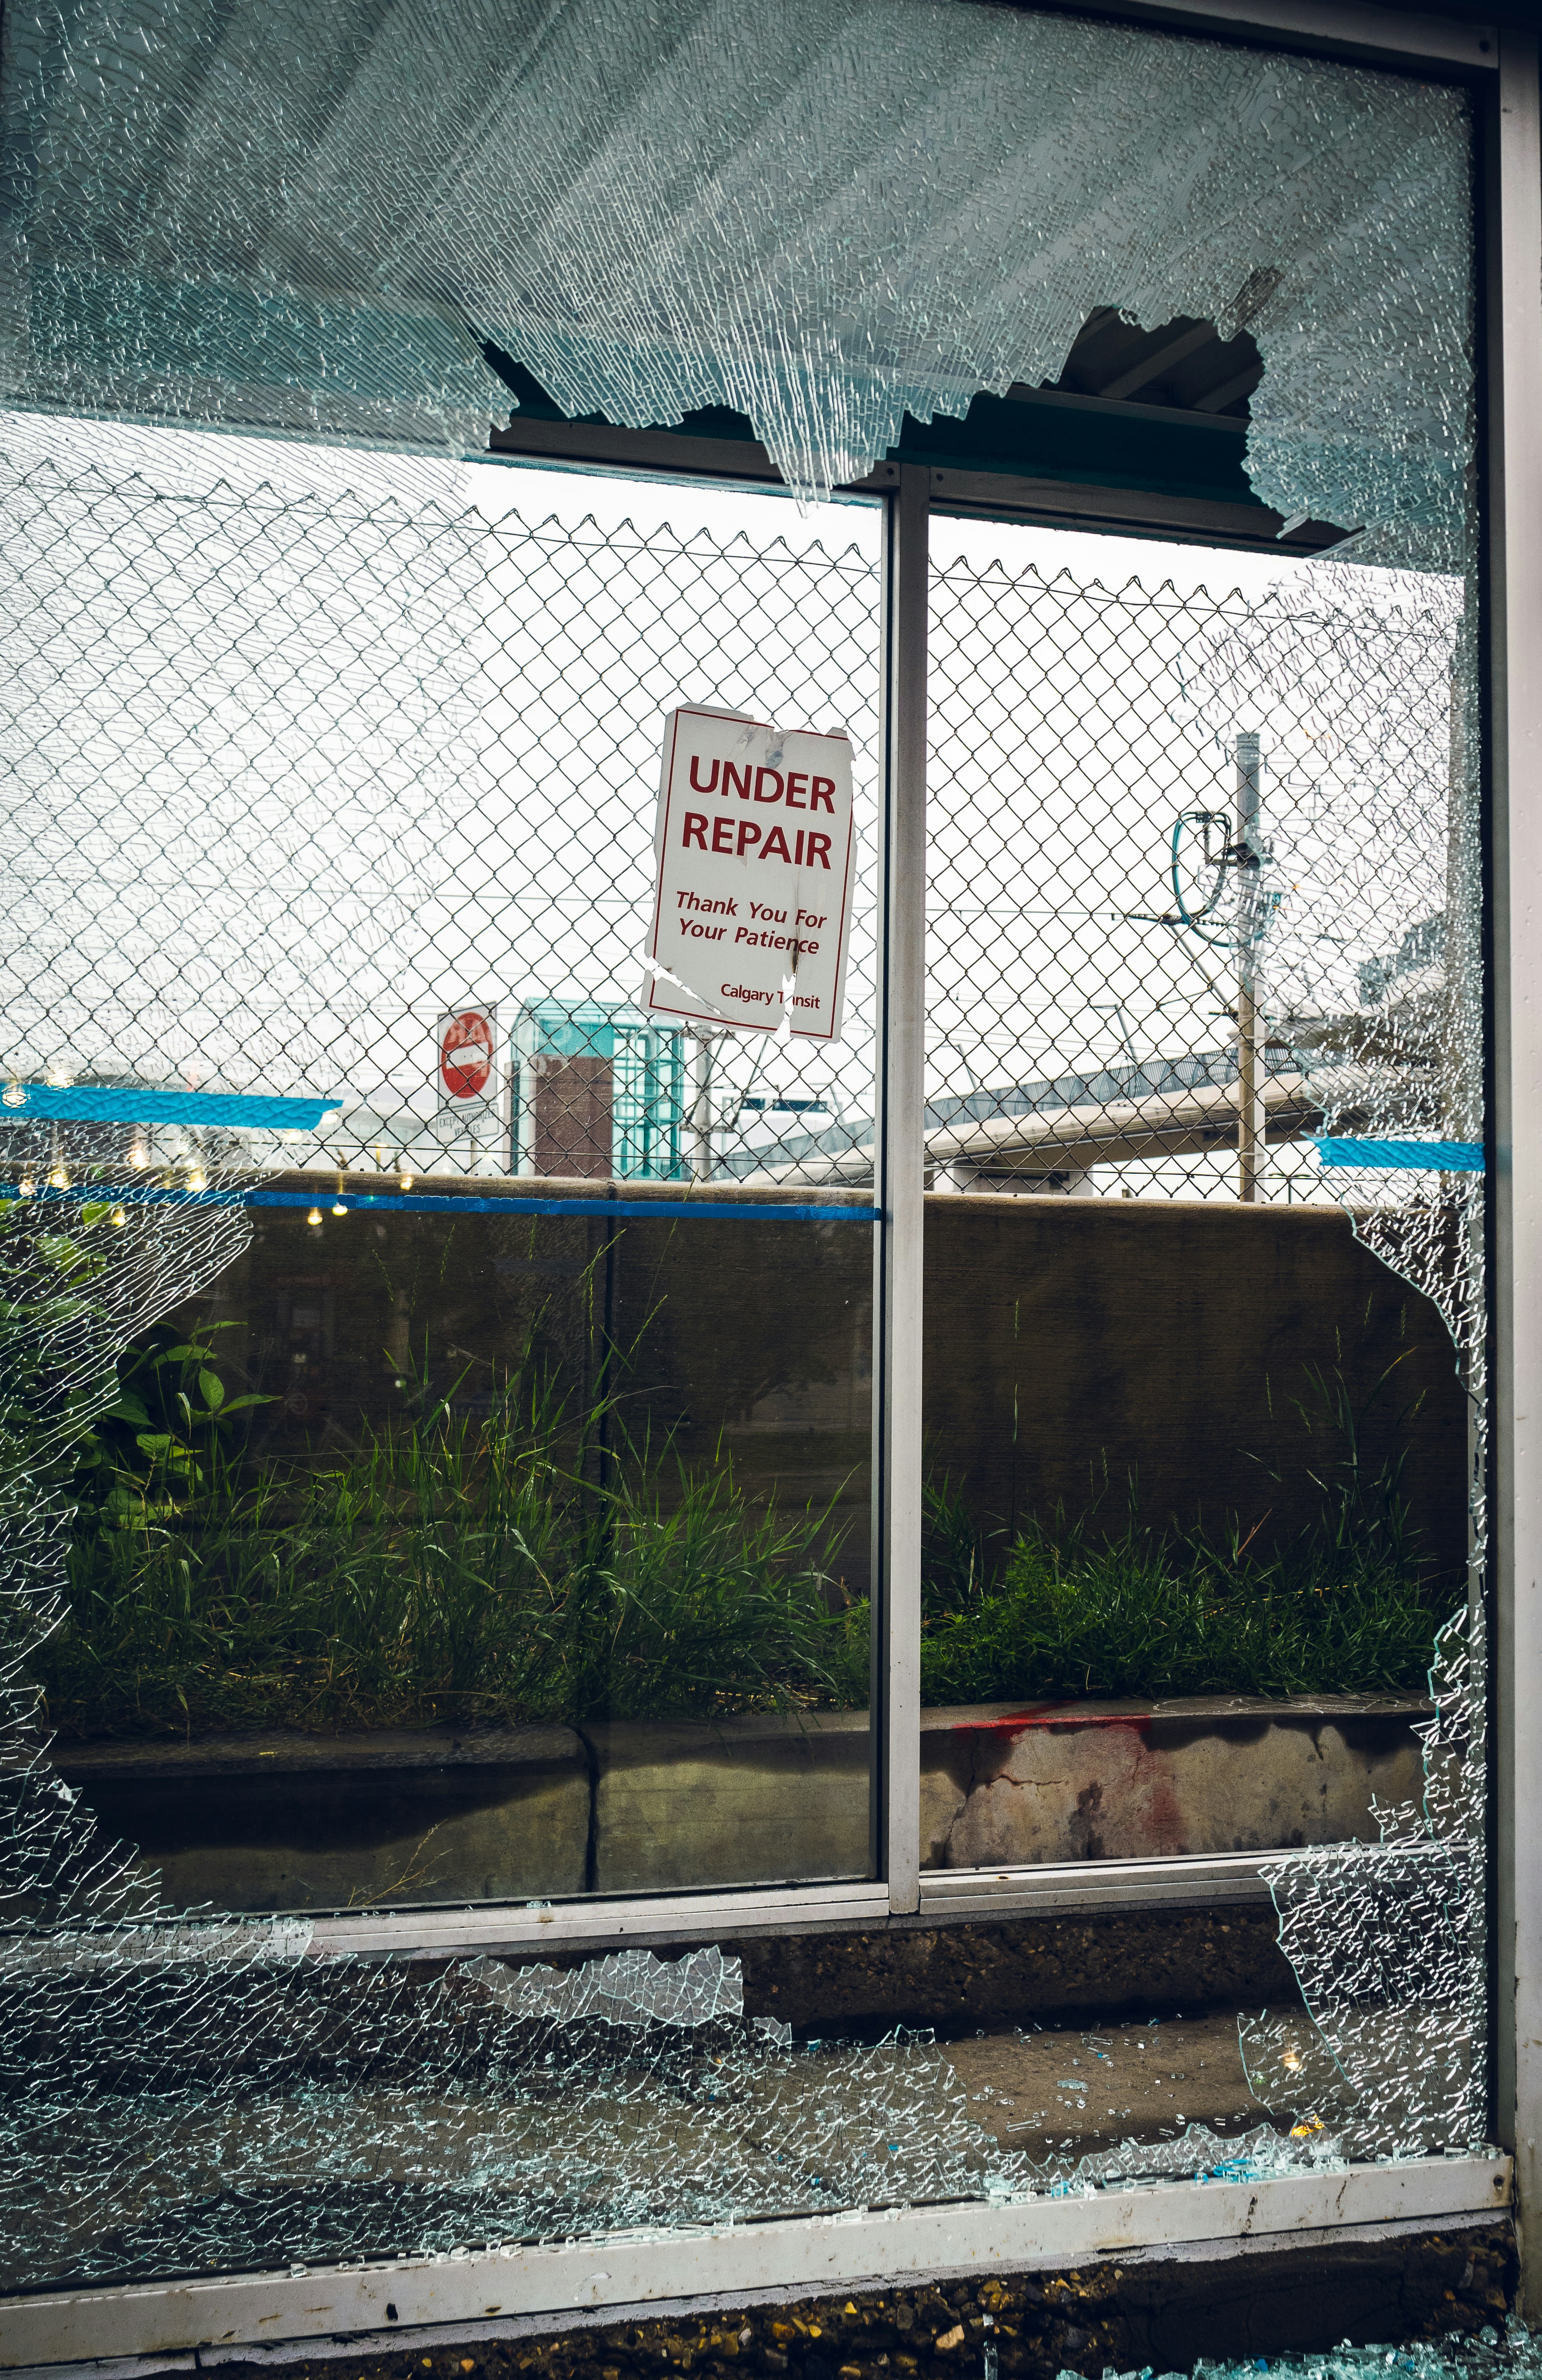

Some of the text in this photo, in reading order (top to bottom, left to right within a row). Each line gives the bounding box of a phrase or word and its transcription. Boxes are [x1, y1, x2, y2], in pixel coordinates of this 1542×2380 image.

[690, 755, 836, 814] UNDER
[682, 812, 832, 870] REPAIR
[677, 891, 827, 928] Thank You For
[680, 918, 819, 954] Your Patience
[721, 983, 820, 1009] Calgary Tnsit
[439, 1109, 496, 1128] EXCEPT AUTHORIZED
[454, 1124, 481, 1136] VEHLES
